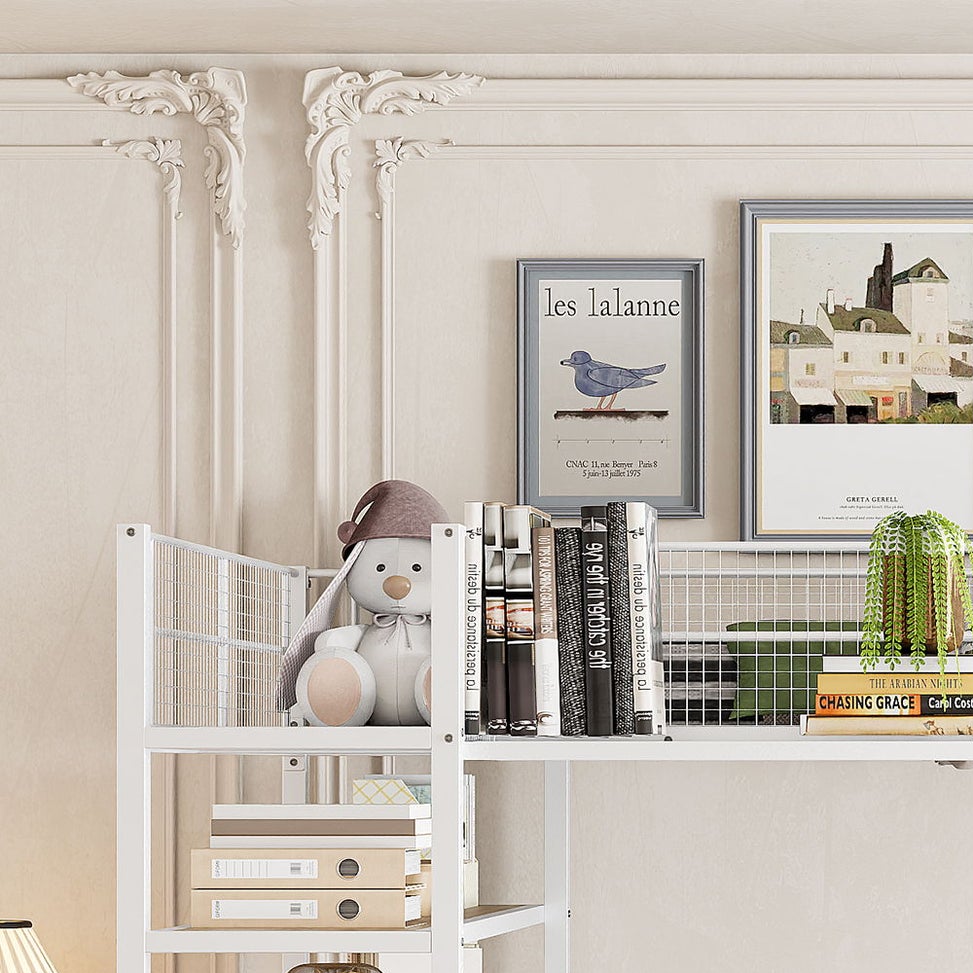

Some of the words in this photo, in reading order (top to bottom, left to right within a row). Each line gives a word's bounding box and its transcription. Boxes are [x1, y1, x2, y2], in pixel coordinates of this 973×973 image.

[545, 288, 576, 316] les
[588, 288, 680, 316] lalanne
[566, 460, 589, 468] CNAC
[638, 460, 653, 468] Paris
[609, 470, 626, 479] juillet
[870, 679, 886, 689] THE
[890, 679, 927, 689] ARABIAN
[819, 696, 873, 709] CHASING
[876, 696, 915, 709] GRACE
[928, 697, 952, 709] Carol
